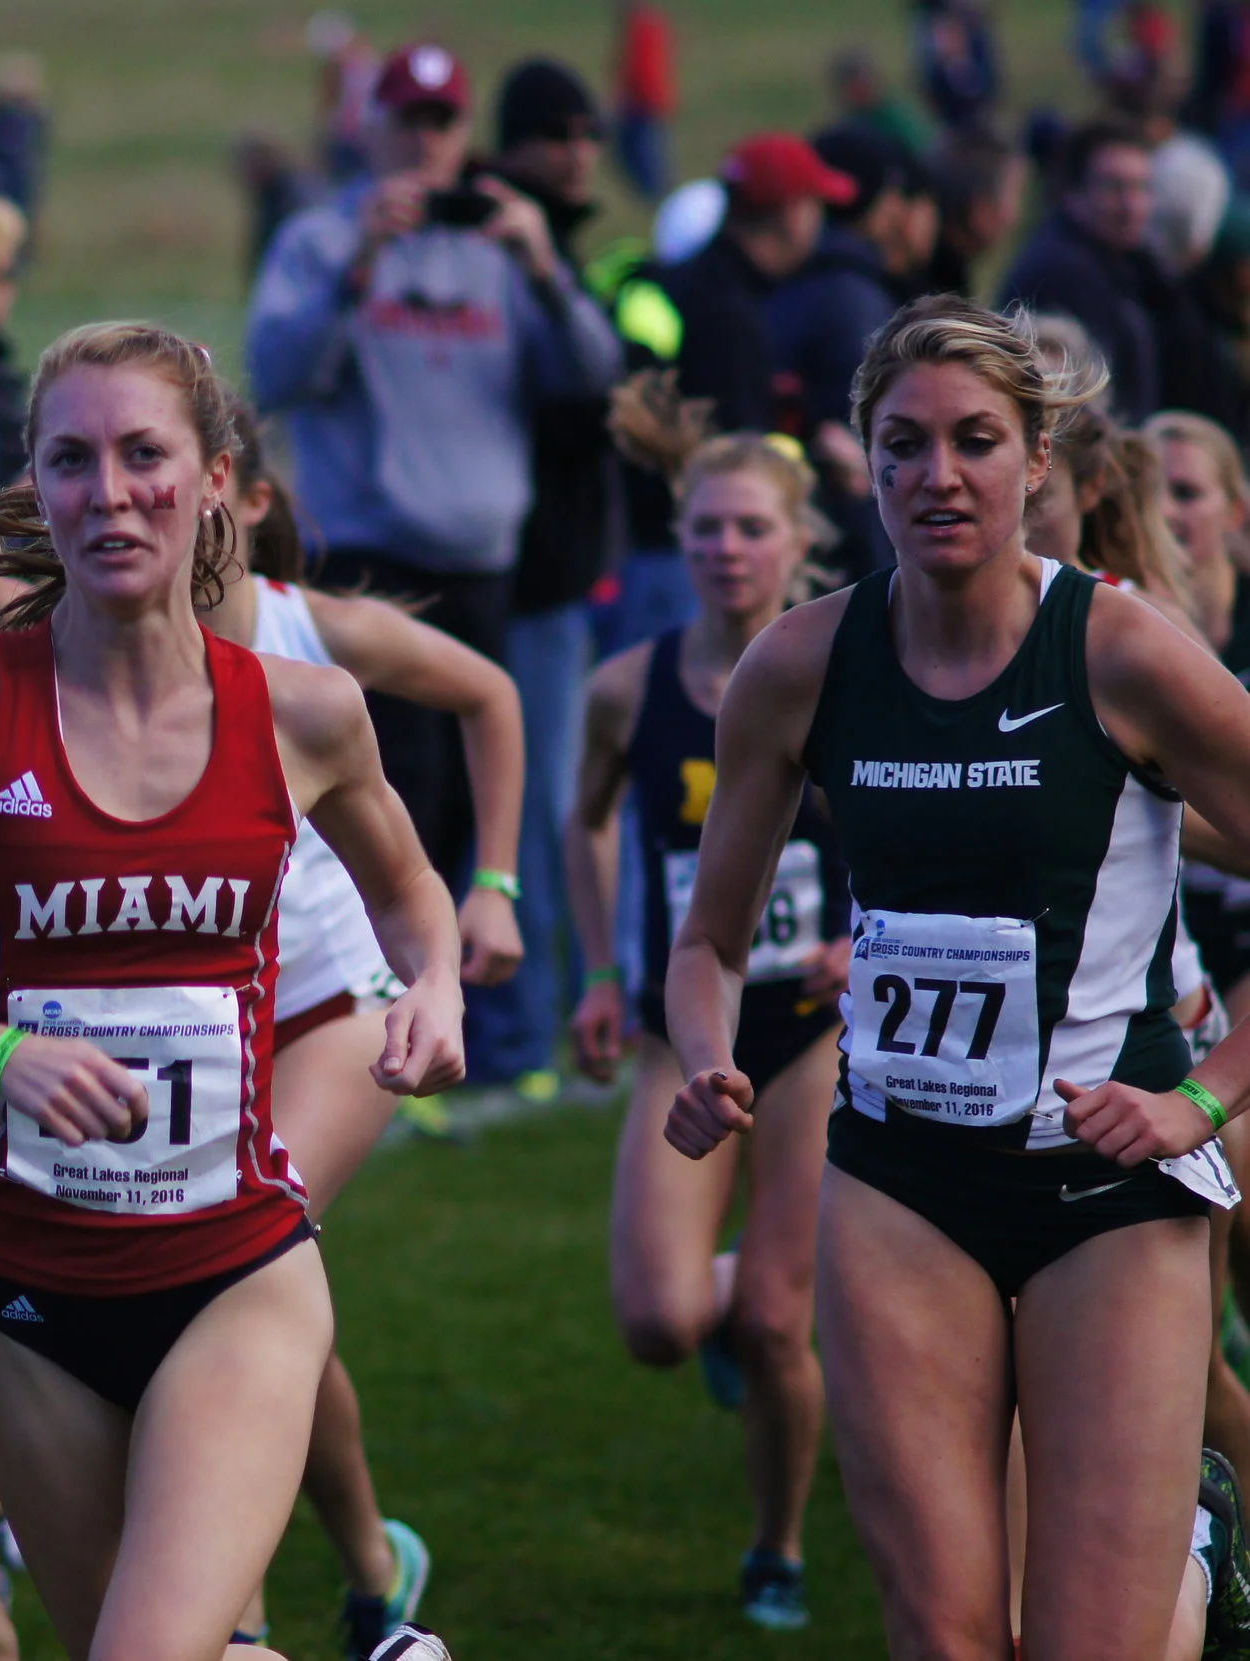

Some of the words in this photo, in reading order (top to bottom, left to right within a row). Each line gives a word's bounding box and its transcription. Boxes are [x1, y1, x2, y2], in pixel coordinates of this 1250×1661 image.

[850, 760, 962, 788] MICHIGAN
[967, 760, 1041, 787] STATE
[14, 875, 250, 939] MIAMI
[871, 941, 900, 956] CROSS
[902, 945, 944, 959] COUNTRY
[946, 948, 1030, 962] CHAMPIONSHIPS
[873, 974, 1006, 1060] 277
[41, 1026, 80, 1037] CROSS
[82, 1025, 136, 1037] COUNTRY
[139, 1024, 234, 1037] CHAMPIONSHIPS
[886, 1075, 915, 1089] Great
[918, 1079, 947, 1094] Lakes
[950, 1082, 997, 1097] Regional
[945, 1101, 962, 1116] 11,
[965, 1103, 994, 1116] 2016
[53, 1163, 88, 1179] Great
[92, 1167, 130, 1182] Lakes
[135, 1167, 188, 1184] Regional
[56, 1184, 121, 1203] November
[127, 1191, 147, 1206] 11,
[151, 1189, 184, 1203] 2016
[2, 1310, 44, 1323] adidas
